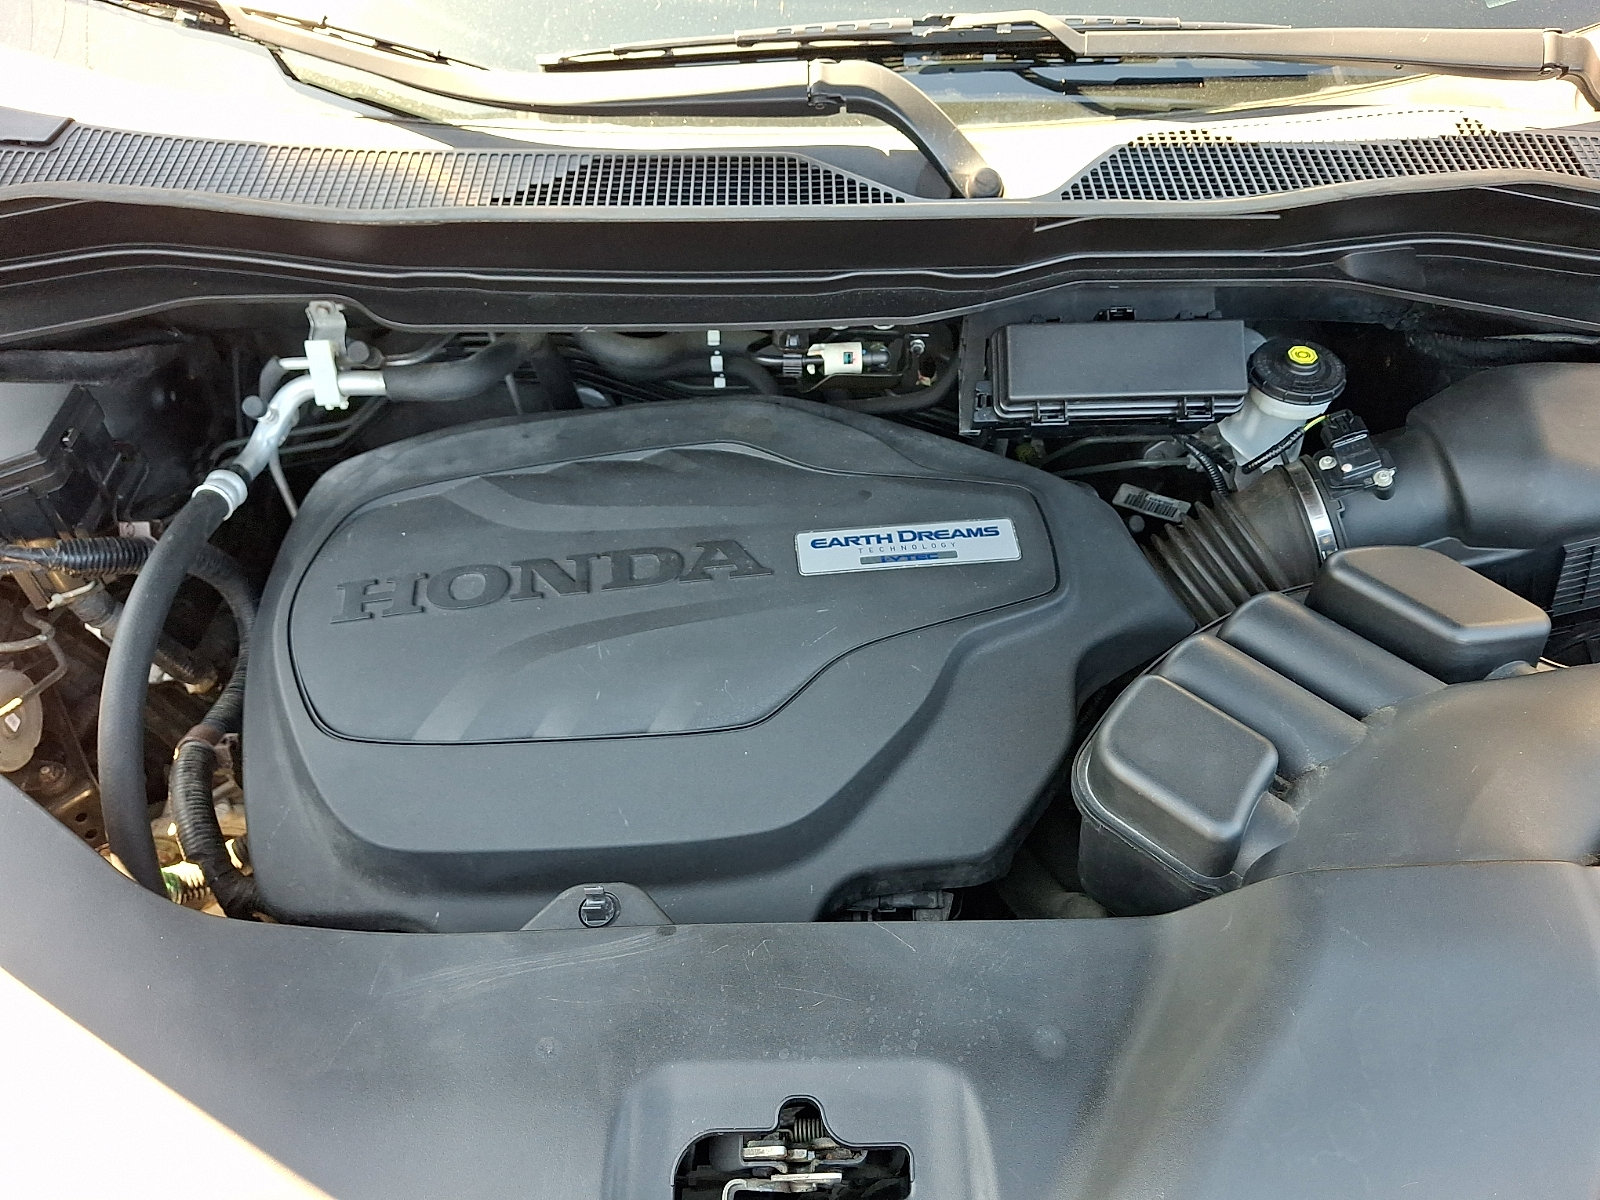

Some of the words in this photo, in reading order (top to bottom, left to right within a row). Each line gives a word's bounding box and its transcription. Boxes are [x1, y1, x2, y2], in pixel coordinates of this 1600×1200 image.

[810, 533, 893, 549] EARTH
[898, 526, 1000, 543] DREAMS
[858, 542, 956, 554] TECHNOLOGY
[331, 539, 775, 624] HONDA
